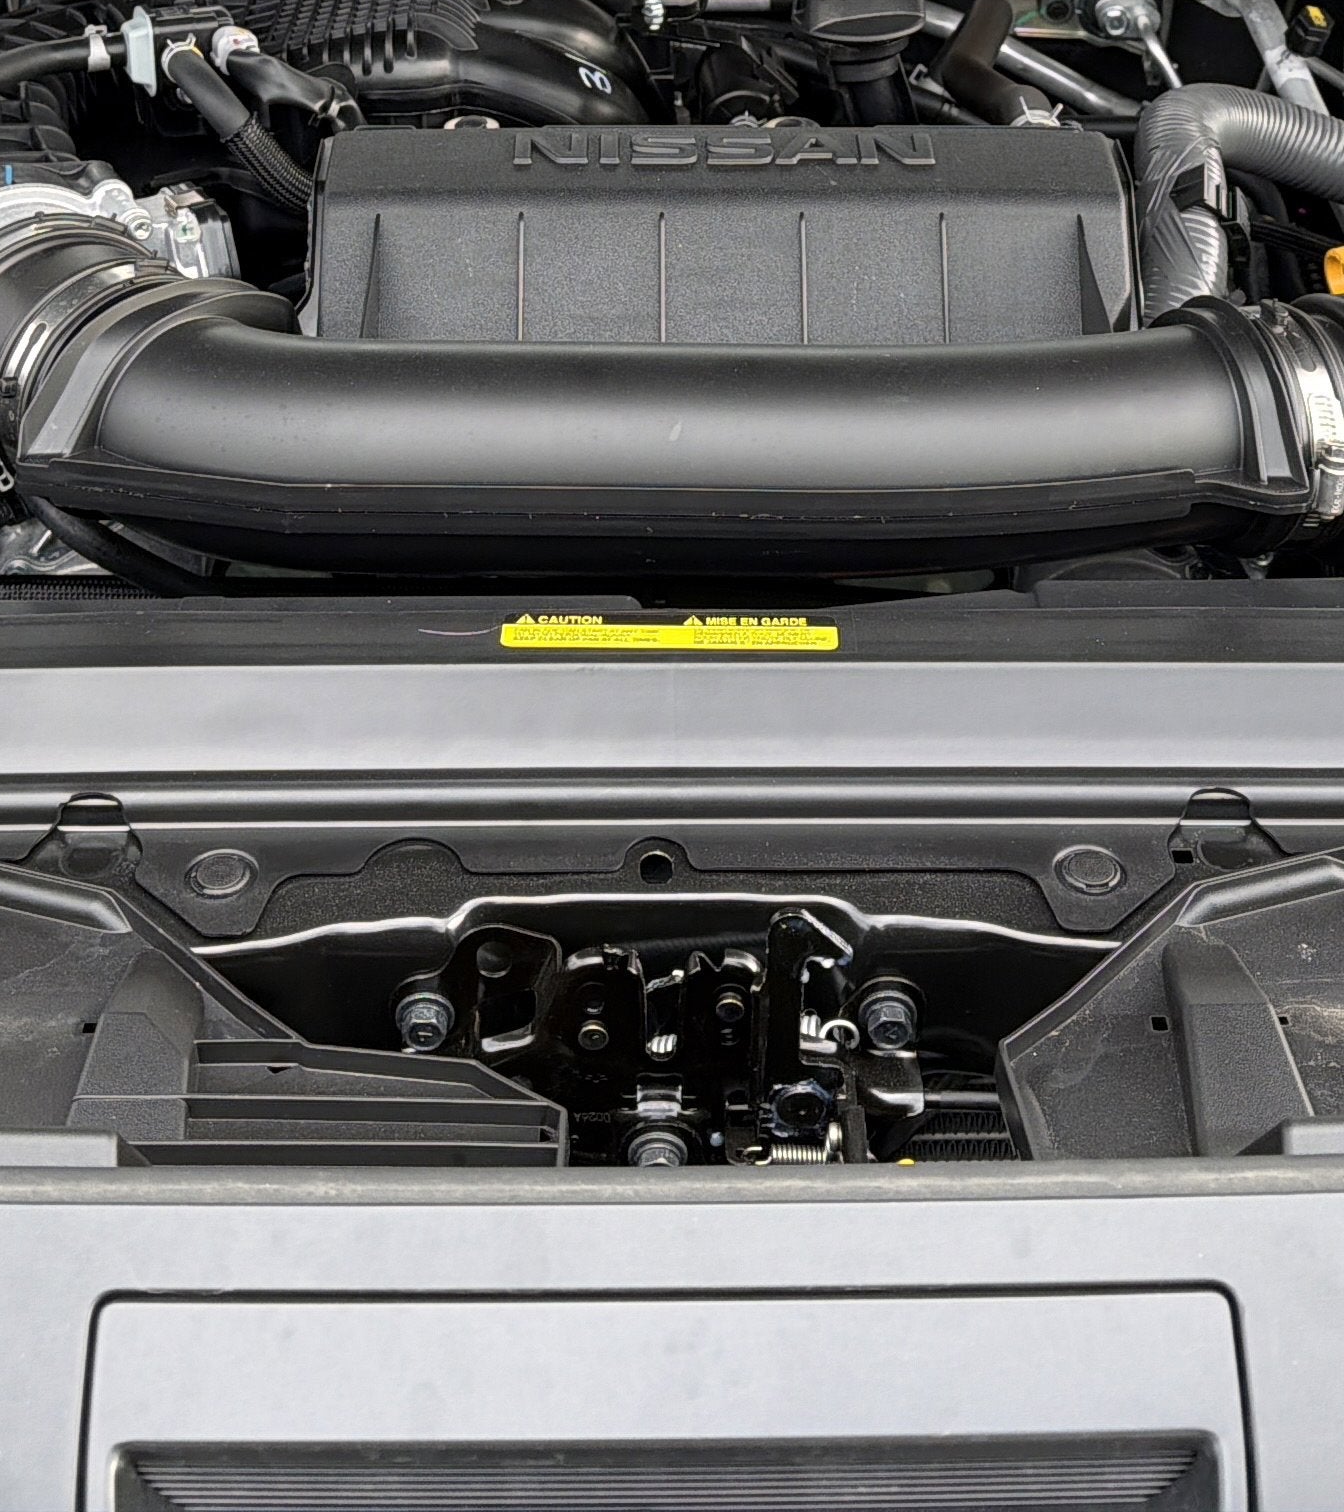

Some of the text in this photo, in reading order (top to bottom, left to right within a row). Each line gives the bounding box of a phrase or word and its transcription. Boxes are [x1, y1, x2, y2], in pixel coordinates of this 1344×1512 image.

[513, 131, 936, 166] NISSAN
[537, 615, 603, 625] CAUTION
[706, 616, 808, 627] MISE EN GARDE
